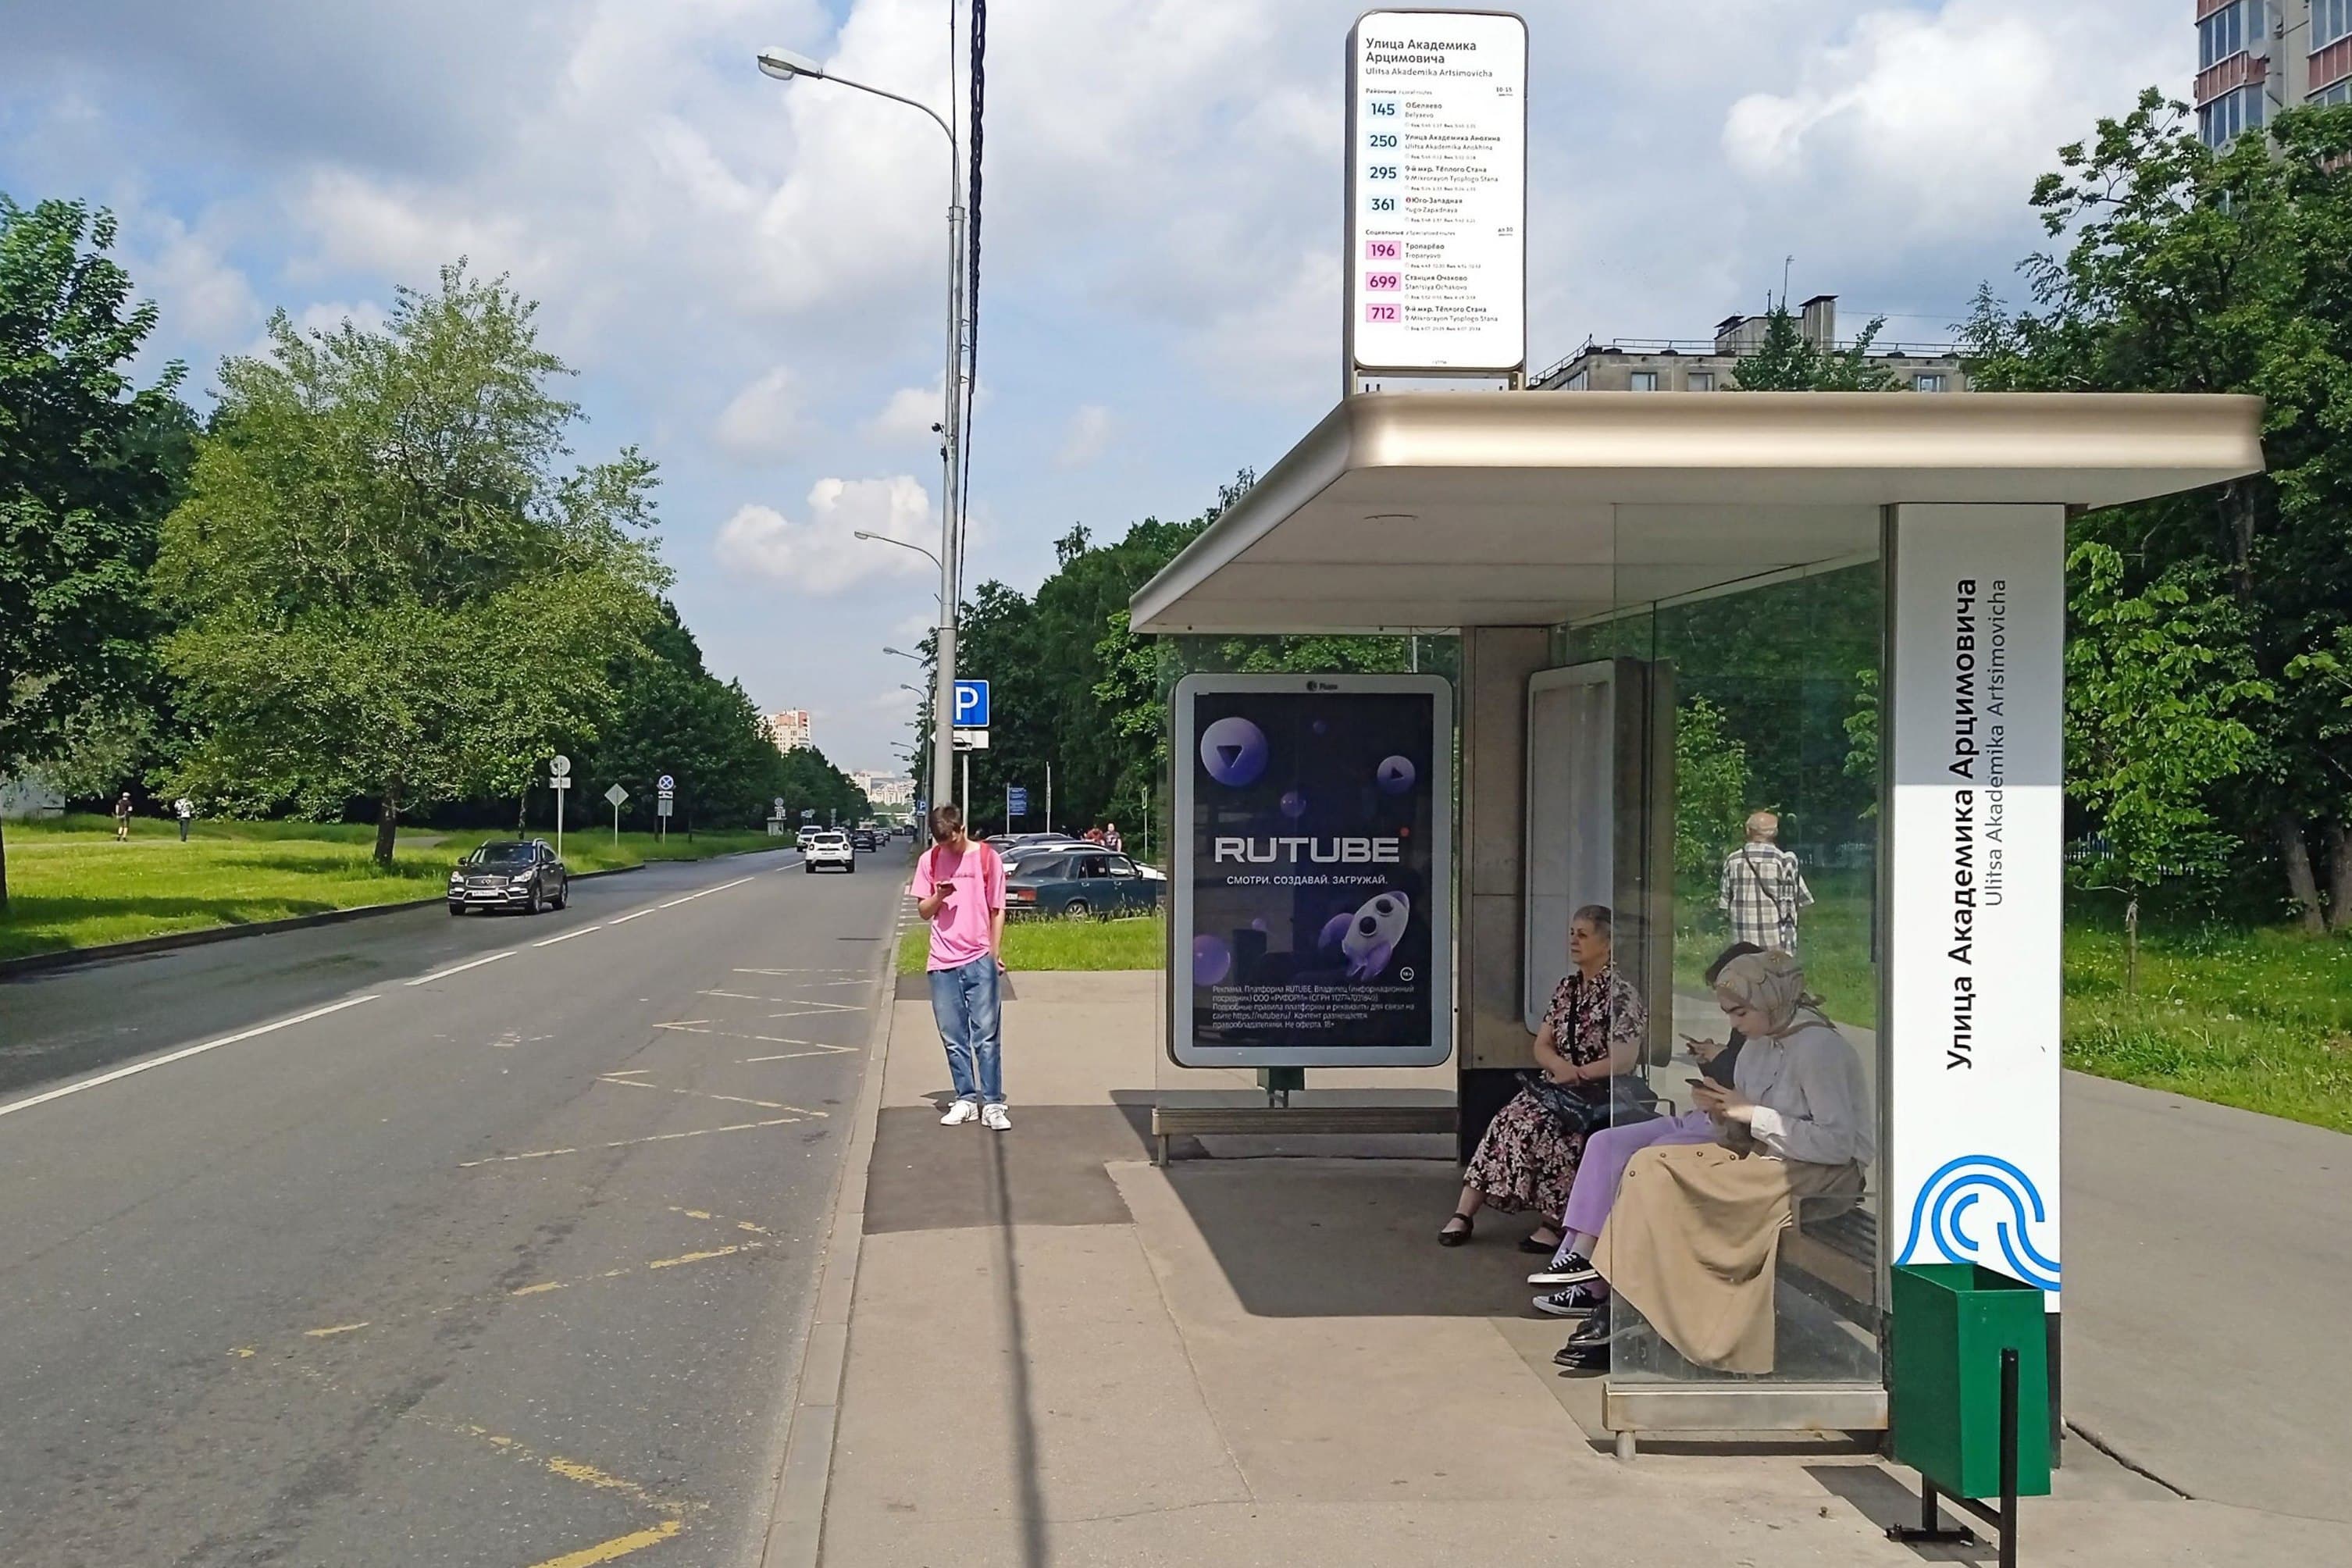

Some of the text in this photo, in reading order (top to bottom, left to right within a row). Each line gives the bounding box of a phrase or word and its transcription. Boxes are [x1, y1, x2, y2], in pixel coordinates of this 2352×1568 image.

[1366, 38, 1477, 52] Улица Академика
[1366, 52, 1445, 64] Арцимовича
[1392, 68, 1438, 77] Akademika
[1439, 69, 1493, 77] Artsimovicha
[1371, 103, 1395, 116] 145
[1370, 134, 1397, 148] 250
[1370, 166, 1396, 179] 295
[1371, 198, 1395, 211] 361
[1371, 244, 1395, 256] 196
[1370, 276, 1396, 288] 699
[1372, 307, 1395, 319] 712
[955, 686, 978, 721] P
[1984, 579, 2005, 906] Ulitsa Akademika Artsimovicha
[1947, 579, 1980, 1070] Улица Академика Арцимовича
[1214, 837, 1399, 863] RUTUBE
[1227, 875, 1271, 885] СМОТРИ.
[1332, 874, 1388, 885] ЗАГРУЖАЙ.
